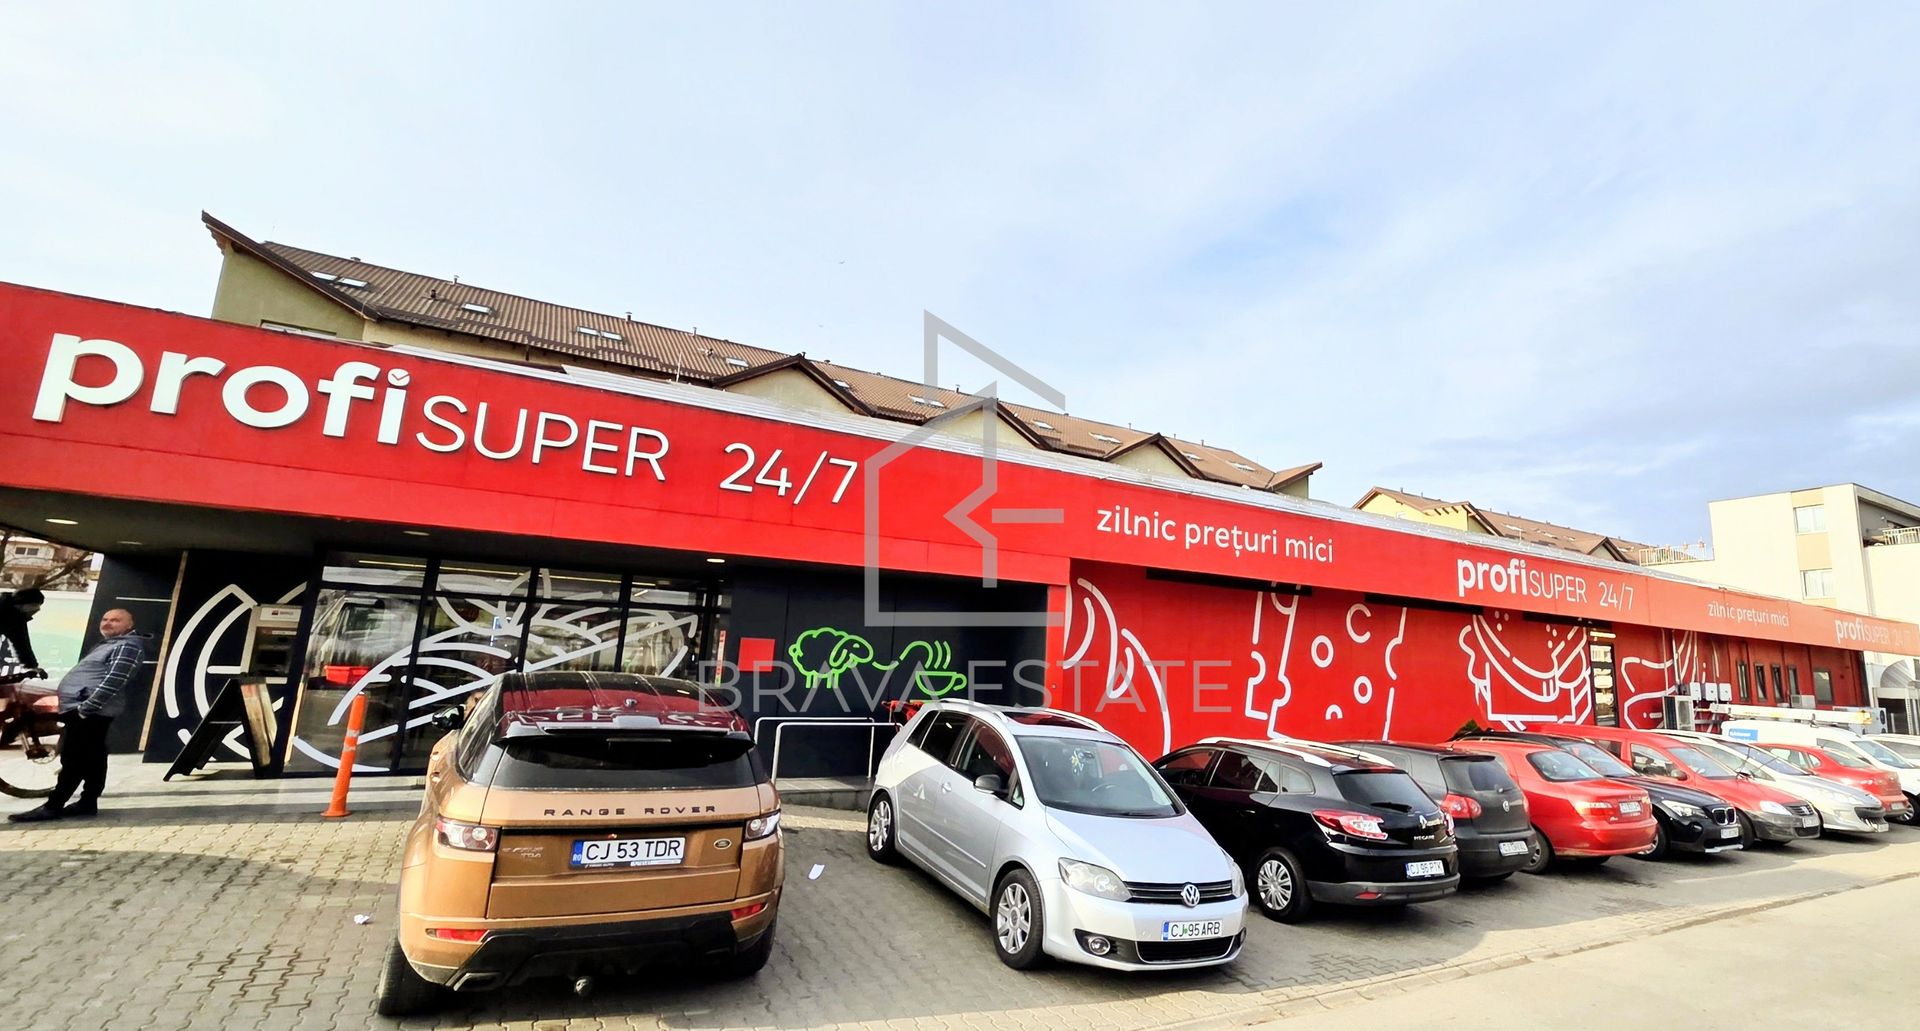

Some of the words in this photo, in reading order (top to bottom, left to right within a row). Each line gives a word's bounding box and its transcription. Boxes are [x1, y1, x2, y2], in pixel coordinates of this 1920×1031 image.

[720, 442, 858, 505] 24/7
[1096, 505, 1176, 541] zilnic
[1185, 523, 1277, 558] prețuri
[1285, 536, 1333, 563] mici
[1599, 581, 1634, 611] 24/7
[1708, 600, 1735, 619] zilnic
[1771, 611, 1789, 627] mici
[544, 808, 626, 817] RANGE
[644, 805, 717, 814] ROVER
[586, 843, 611, 861] CJ
[617, 841, 639, 859] 53
[645, 840, 681, 858] TDR
[1171, 924, 1185, 938] CJ
[1188, 923, 1199, 937] 95
[1201, 922, 1221, 936] ARB
